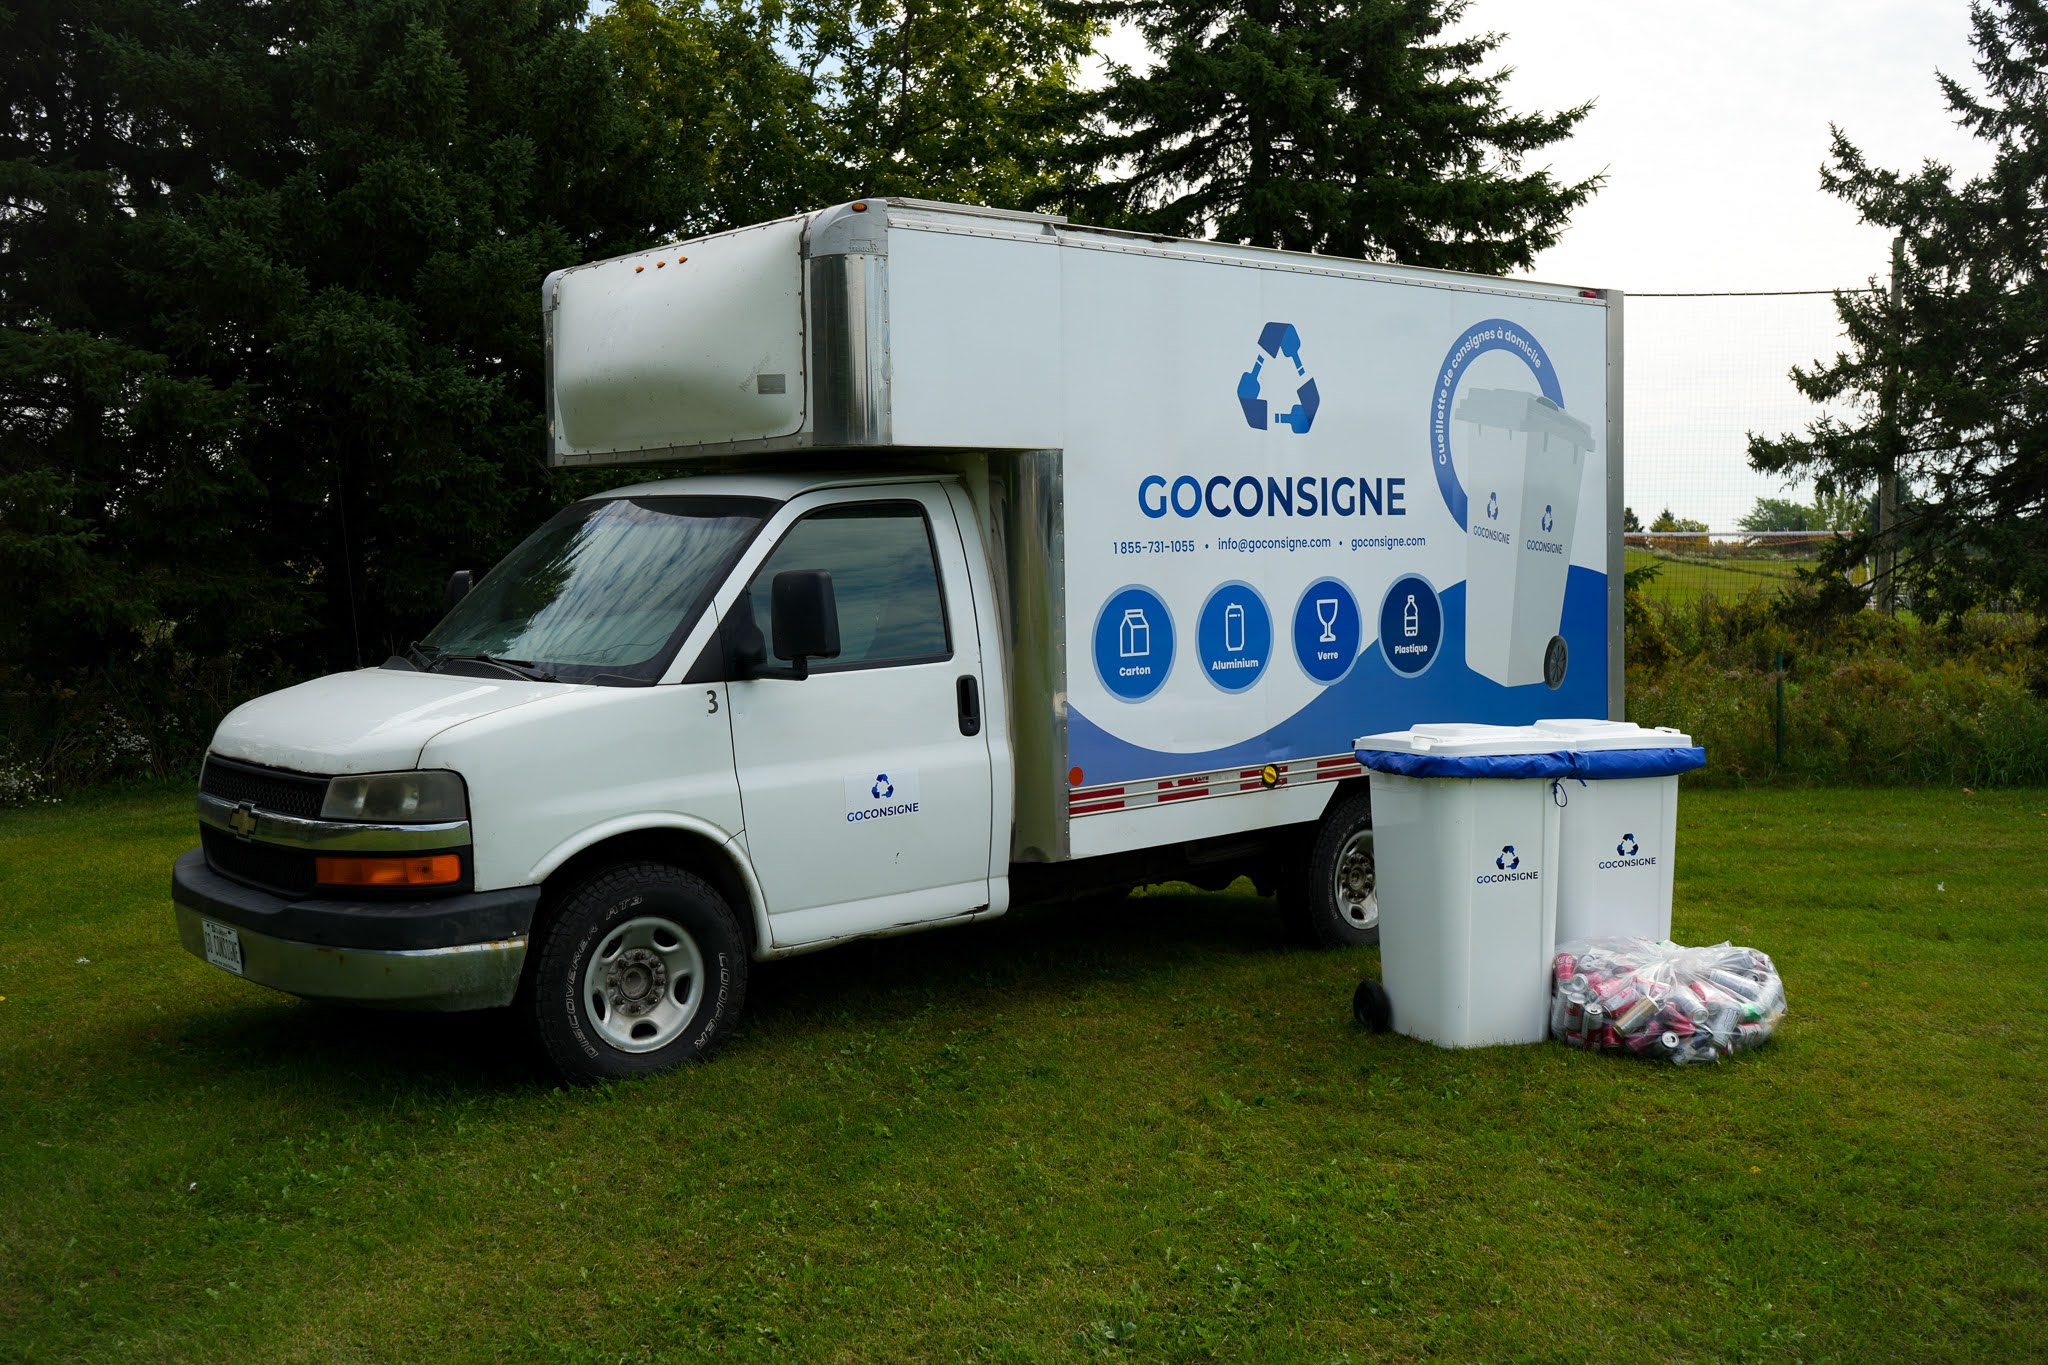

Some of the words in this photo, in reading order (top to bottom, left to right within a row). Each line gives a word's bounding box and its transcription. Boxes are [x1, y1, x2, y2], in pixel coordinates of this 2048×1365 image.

[1435, 389, 1447, 465] Cueillette
[1444, 369, 1454, 386] de
[1451, 329, 1495, 368] consignes
[1497, 327, 1502, 339] à
[1505, 330, 1541, 368] domicile
[1138, 475, 1406, 518] GOCONSIGNE
[1473, 526, 1510, 545] GOCONSIGNE
[1120, 541, 1195, 553] 855-731-1055
[1218, 536, 1331, 552] info@goconsigne.com
[1351, 536, 1426, 551] goconsigne.com
[1527, 540, 1562, 554] GOCONSIGNE
[1318, 651, 1338, 660] Verre
[1395, 644, 1428, 655] Plastique
[1119, 665, 1150, 677] Carton
[1212, 658, 1259, 671] Aluminium
[706, 690, 718, 714] 3
[847, 803, 919, 822] GOCONSIGNE
[1599, 857, 1656, 869] GOCONSIGNE
[1476, 871, 1539, 884] GOCONSIGNE
[565, 924, 599, 1058] DISCOVERER
[606, 896, 642, 920] AT3
[694, 952, 729, 1049] COOPER
